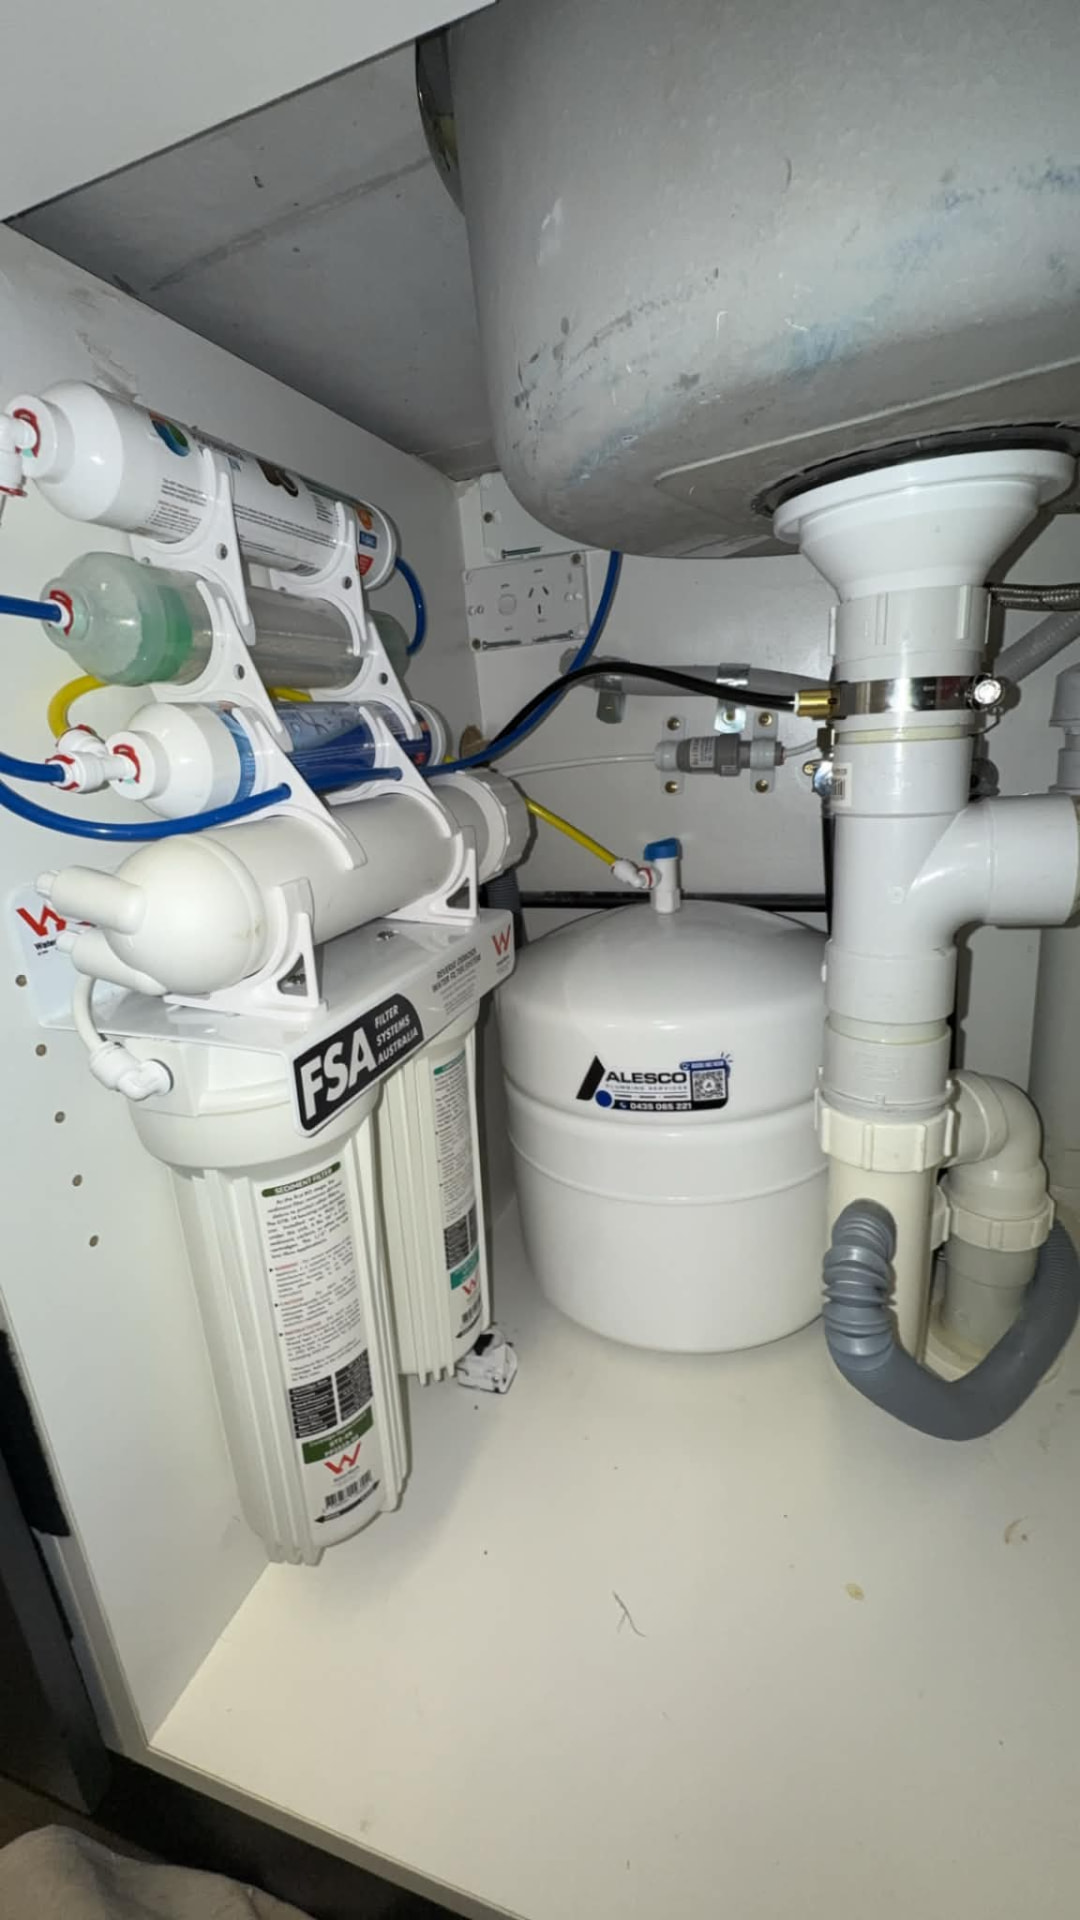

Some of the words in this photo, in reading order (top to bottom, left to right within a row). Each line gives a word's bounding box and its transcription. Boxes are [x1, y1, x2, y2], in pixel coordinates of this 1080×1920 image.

[374, 1004, 399, 1029] FILTER
[375, 1014, 410, 1046] SYSTEMS
[377, 1027, 419, 1065] AUSTRALIA
[300, 1027, 377, 1120] FSA
[606, 1071, 687, 1084] ALESCO
